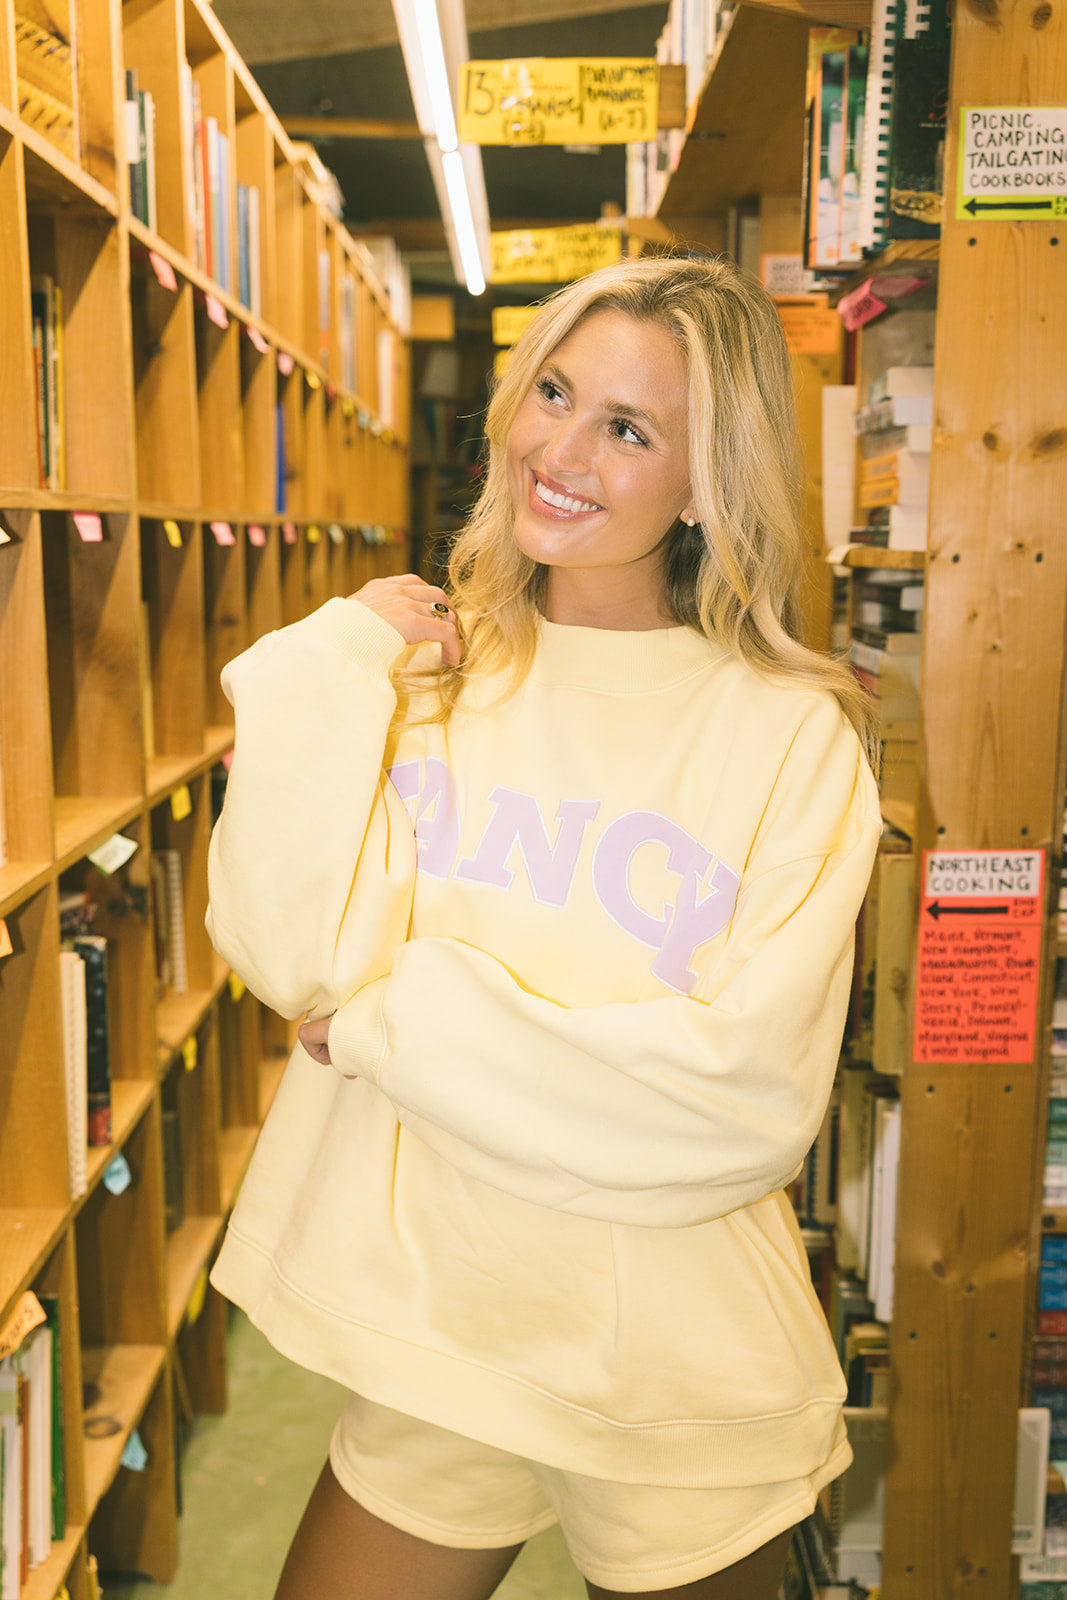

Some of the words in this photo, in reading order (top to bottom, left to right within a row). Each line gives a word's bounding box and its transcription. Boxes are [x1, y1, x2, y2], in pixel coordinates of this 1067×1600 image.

[974, 127, 1065, 149] CAMPING
[967, 149, 1067, 169] TAILGATIN
[969, 171, 1066, 189] COOKBOOKS
[929, 856, 1034, 873] NORTHEAST
[387, 756, 741, 996] ANCY
[930, 874, 1031, 892] COOKING
